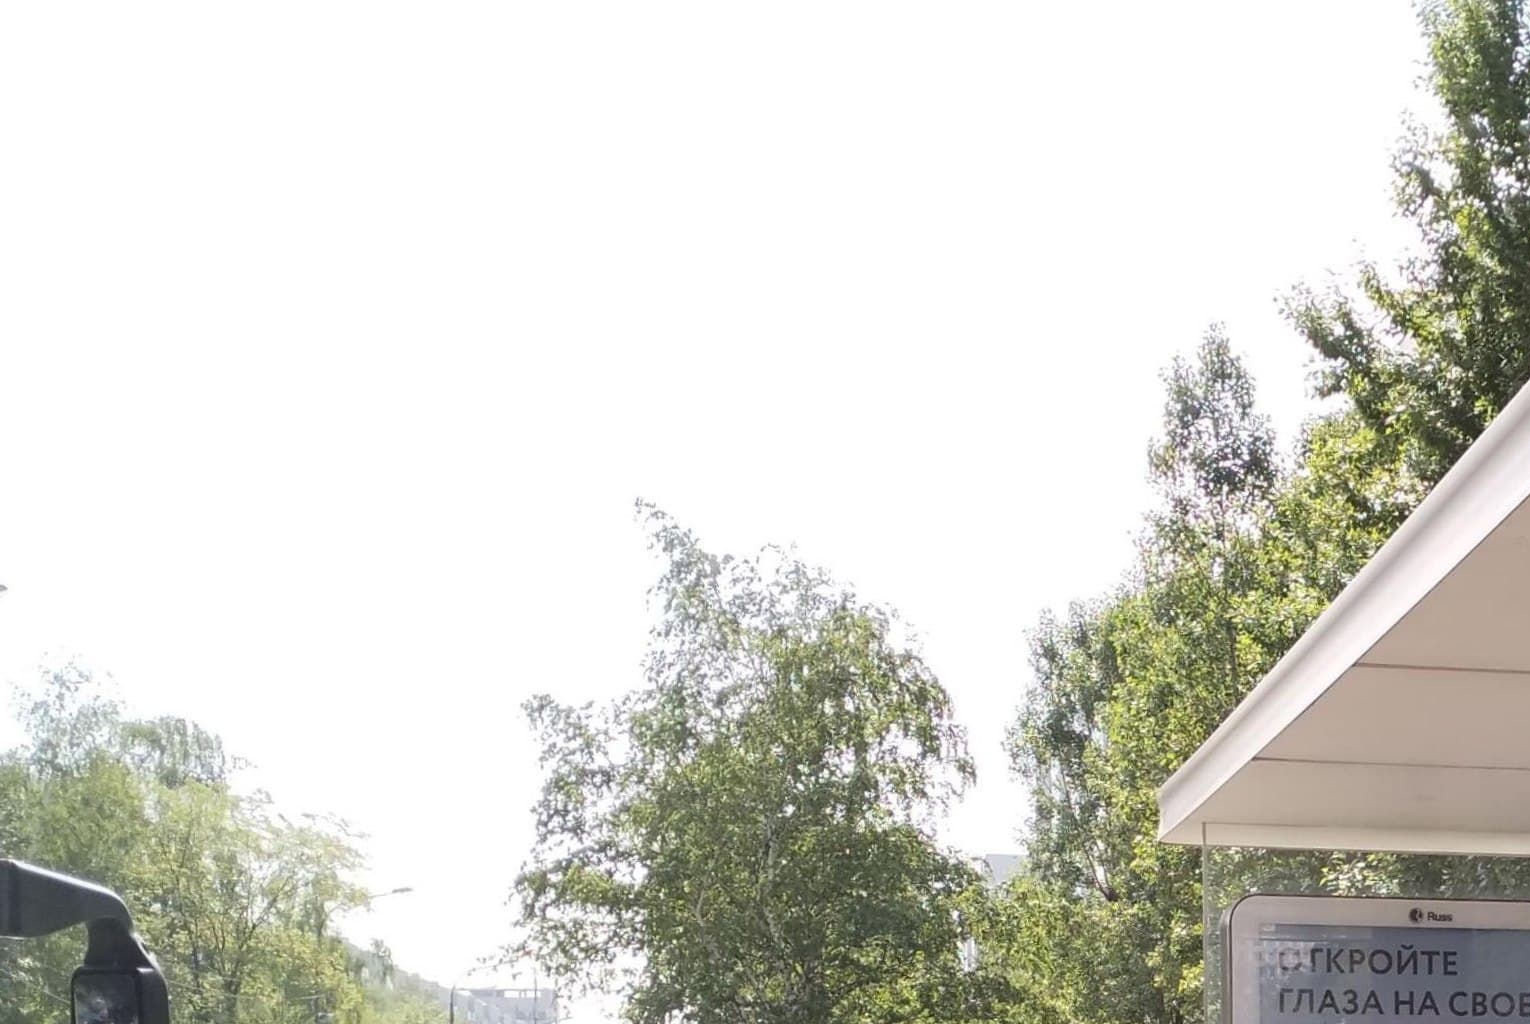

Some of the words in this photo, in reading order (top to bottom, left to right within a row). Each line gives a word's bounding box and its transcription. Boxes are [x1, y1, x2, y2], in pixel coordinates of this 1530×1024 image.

[1278, 944, 1459, 977] ОТКРОЙТЕ
[1278, 987, 1385, 1015] ГЛАЗА
[1394, 990, 1441, 1016] НА
